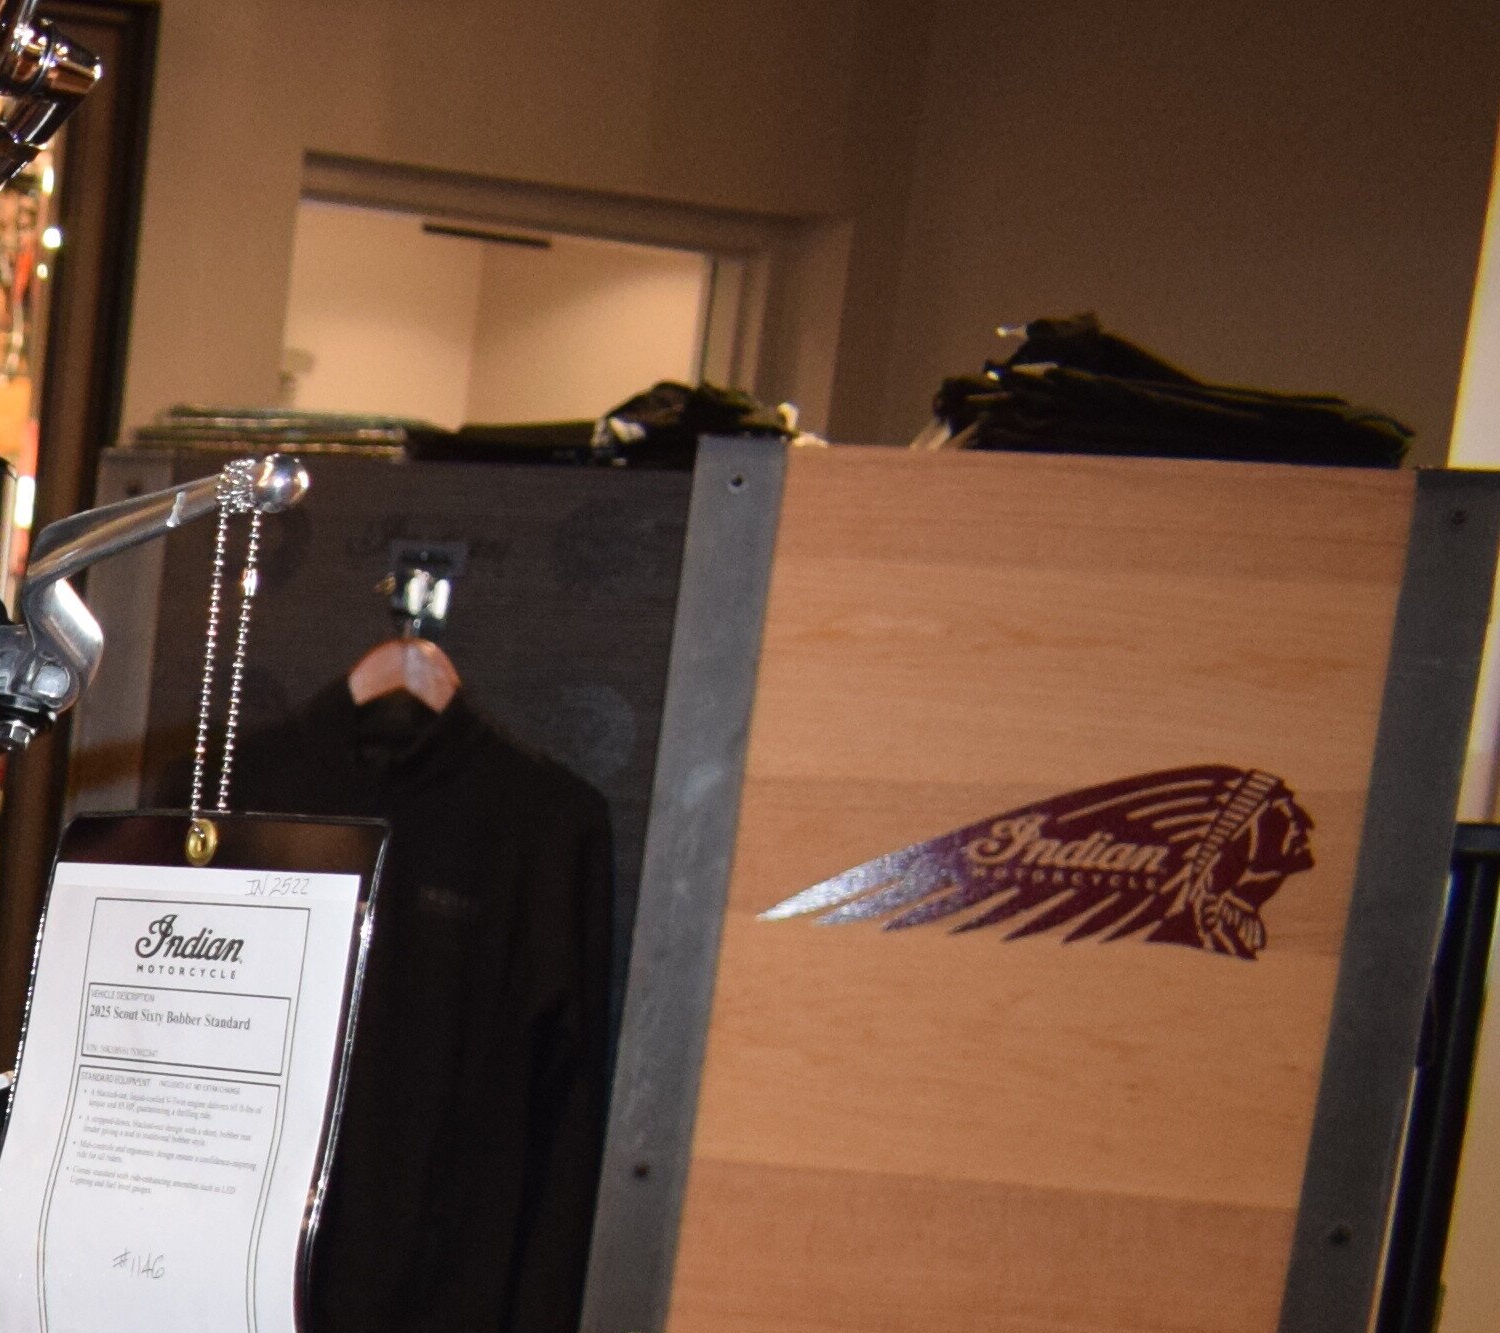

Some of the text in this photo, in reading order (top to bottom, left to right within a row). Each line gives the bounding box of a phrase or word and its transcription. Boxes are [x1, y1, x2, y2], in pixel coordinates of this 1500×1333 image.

[961, 813, 1169, 872] Indian
[135, 913, 245, 963] Indian
[137, 963, 238, 980] MOTORCYCLE
[89, 1004, 251, 1030] 2025 Scout Sixty Bobber Standard
